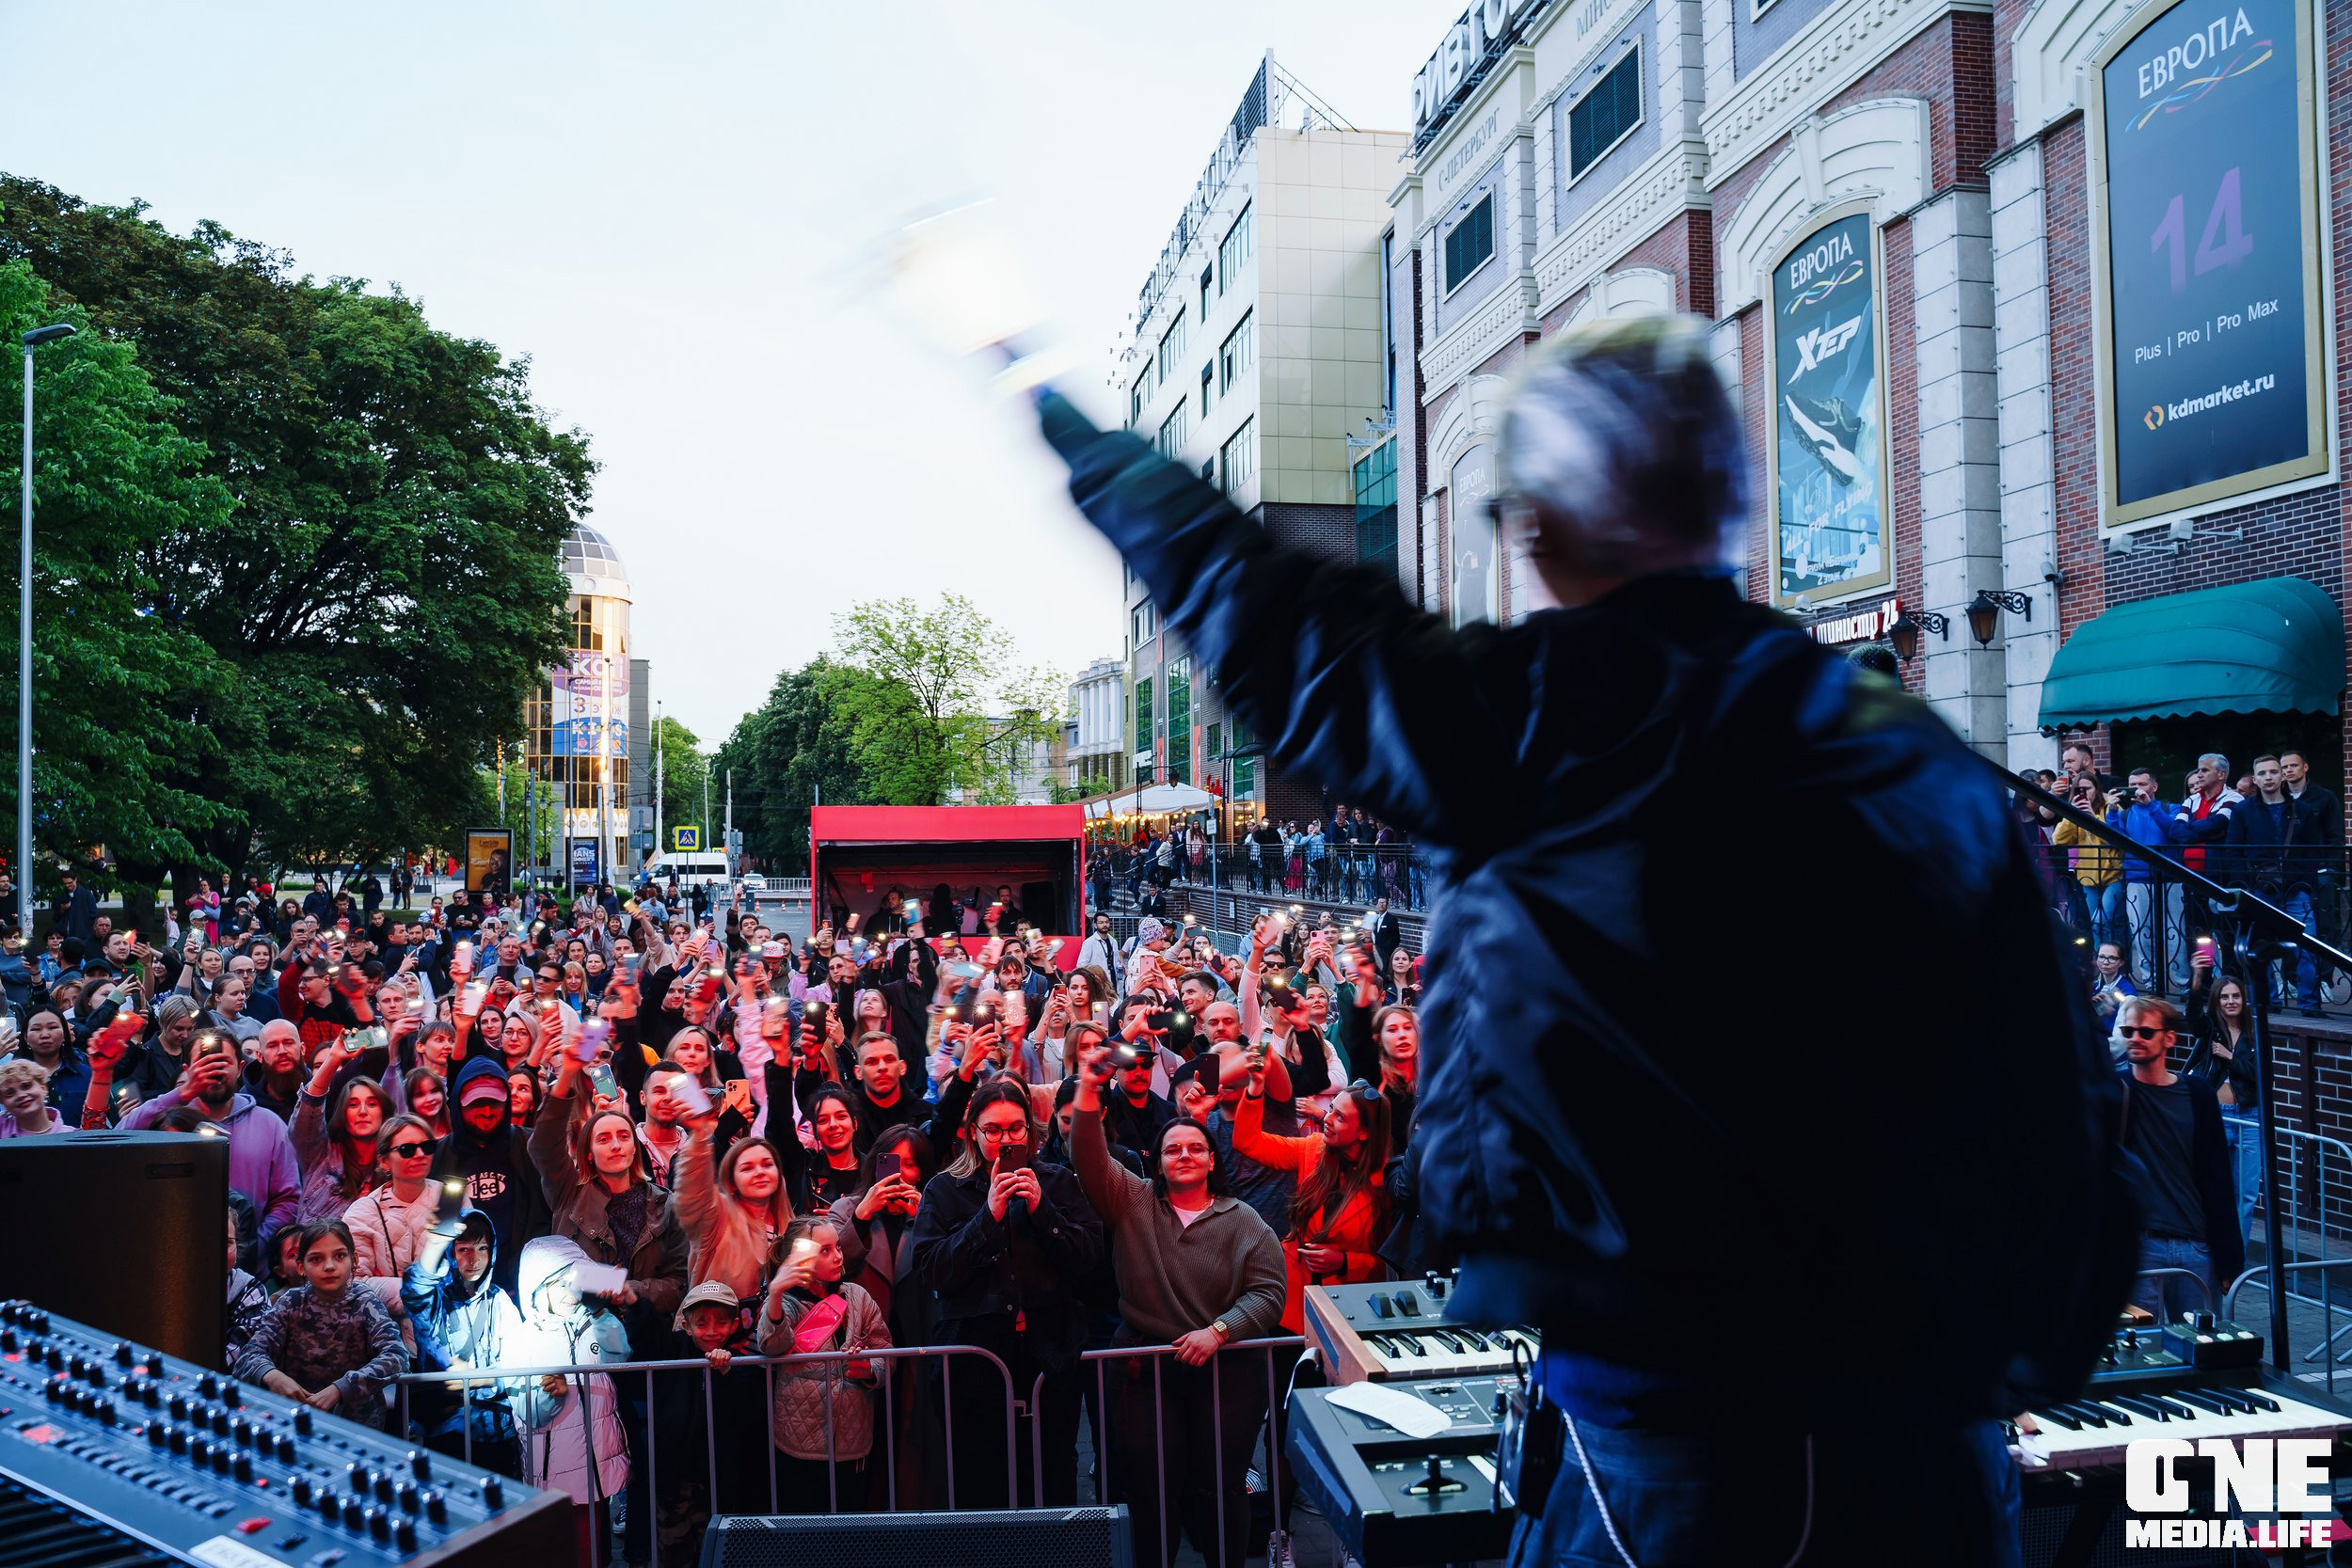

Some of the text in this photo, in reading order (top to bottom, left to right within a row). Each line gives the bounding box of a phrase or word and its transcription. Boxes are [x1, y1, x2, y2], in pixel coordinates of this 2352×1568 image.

[2137, 7, 2254, 99] ЕВРОПА
[1438, 106, 1500, 192] С-ПЕТЕРБУРГ
[1790, 231, 1853, 290] ЕВРОПА
[2151, 166, 2253, 293] 14
[2135, 343, 2162, 364] Plus
[2177, 329, 2201, 349] Pro
[2217, 313, 2241, 333] Pro
[2248, 299, 2279, 322] Max
[2168, 373, 2275, 421] kdmarket.ru
[1808, 512, 1830, 539] FOR
